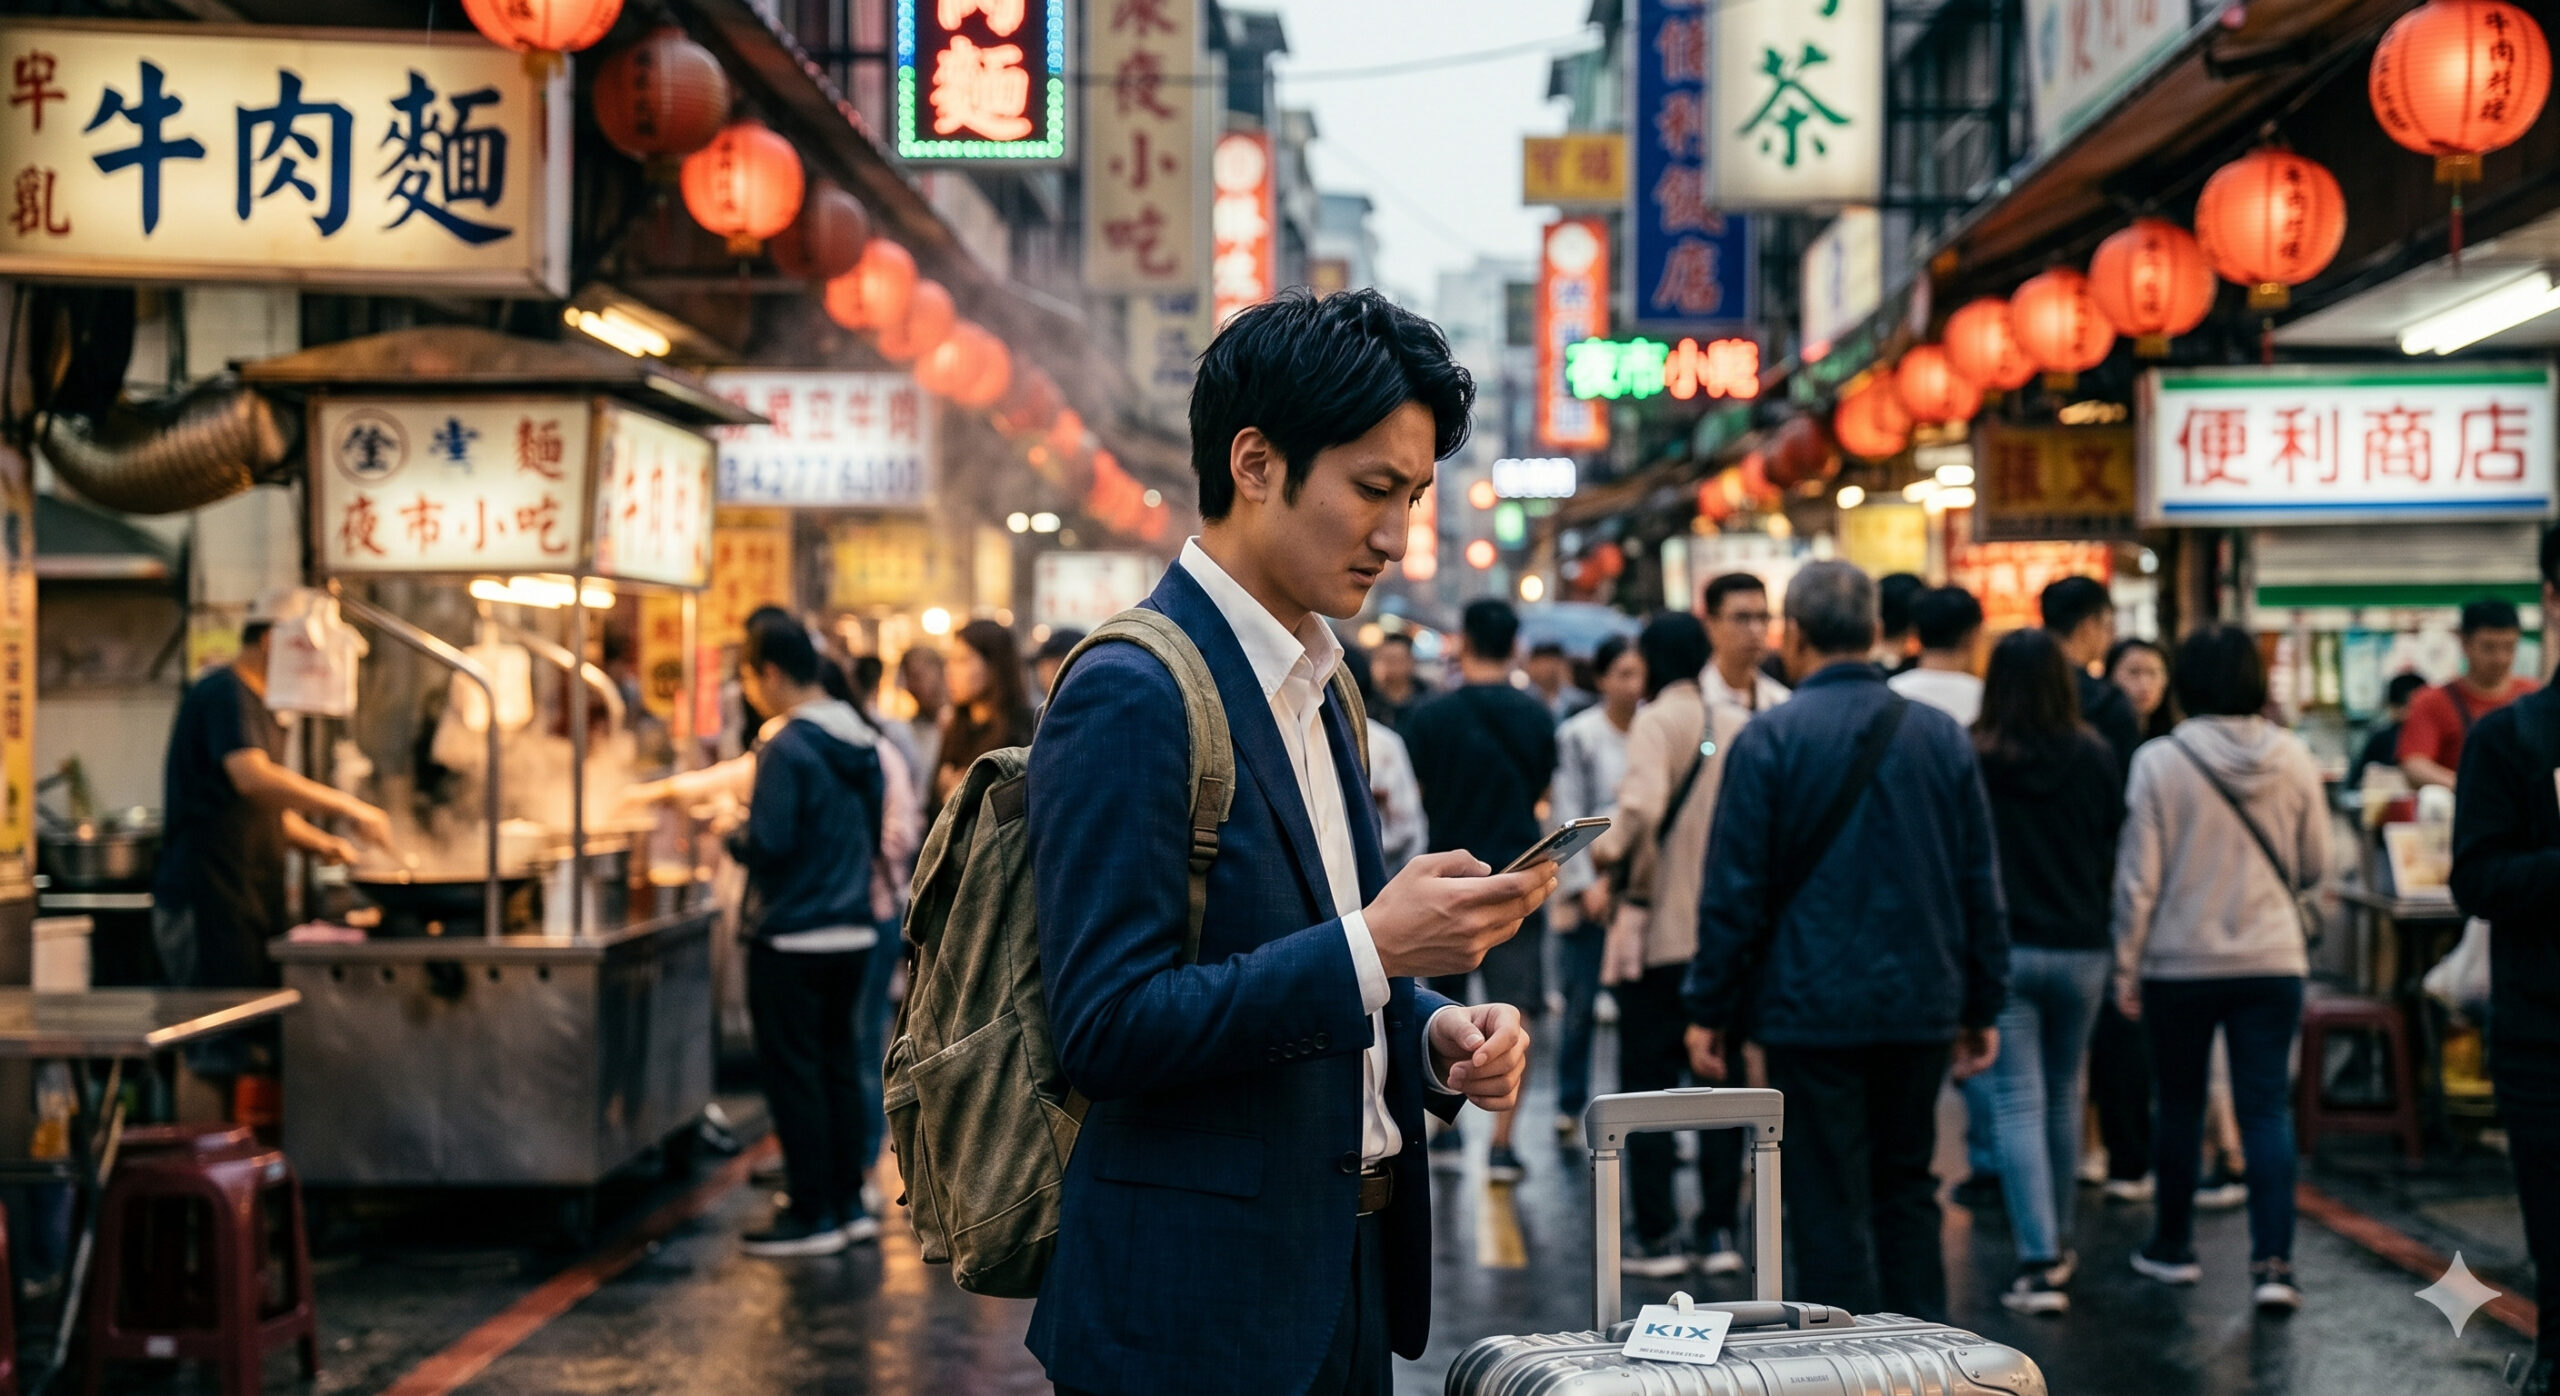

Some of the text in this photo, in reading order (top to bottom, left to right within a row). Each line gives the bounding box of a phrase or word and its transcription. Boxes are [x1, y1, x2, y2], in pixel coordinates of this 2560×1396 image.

[1737, 0, 1853, 169] 茶
[83, 58, 514, 246] 牛肉麵
[1565, 337, 1760, 399] 夜市小吃
[2176, 398, 2529, 485] 便利商店
[338, 492, 569, 556] 夜市小吃
[1644, 1322, 1713, 1341] KIX
